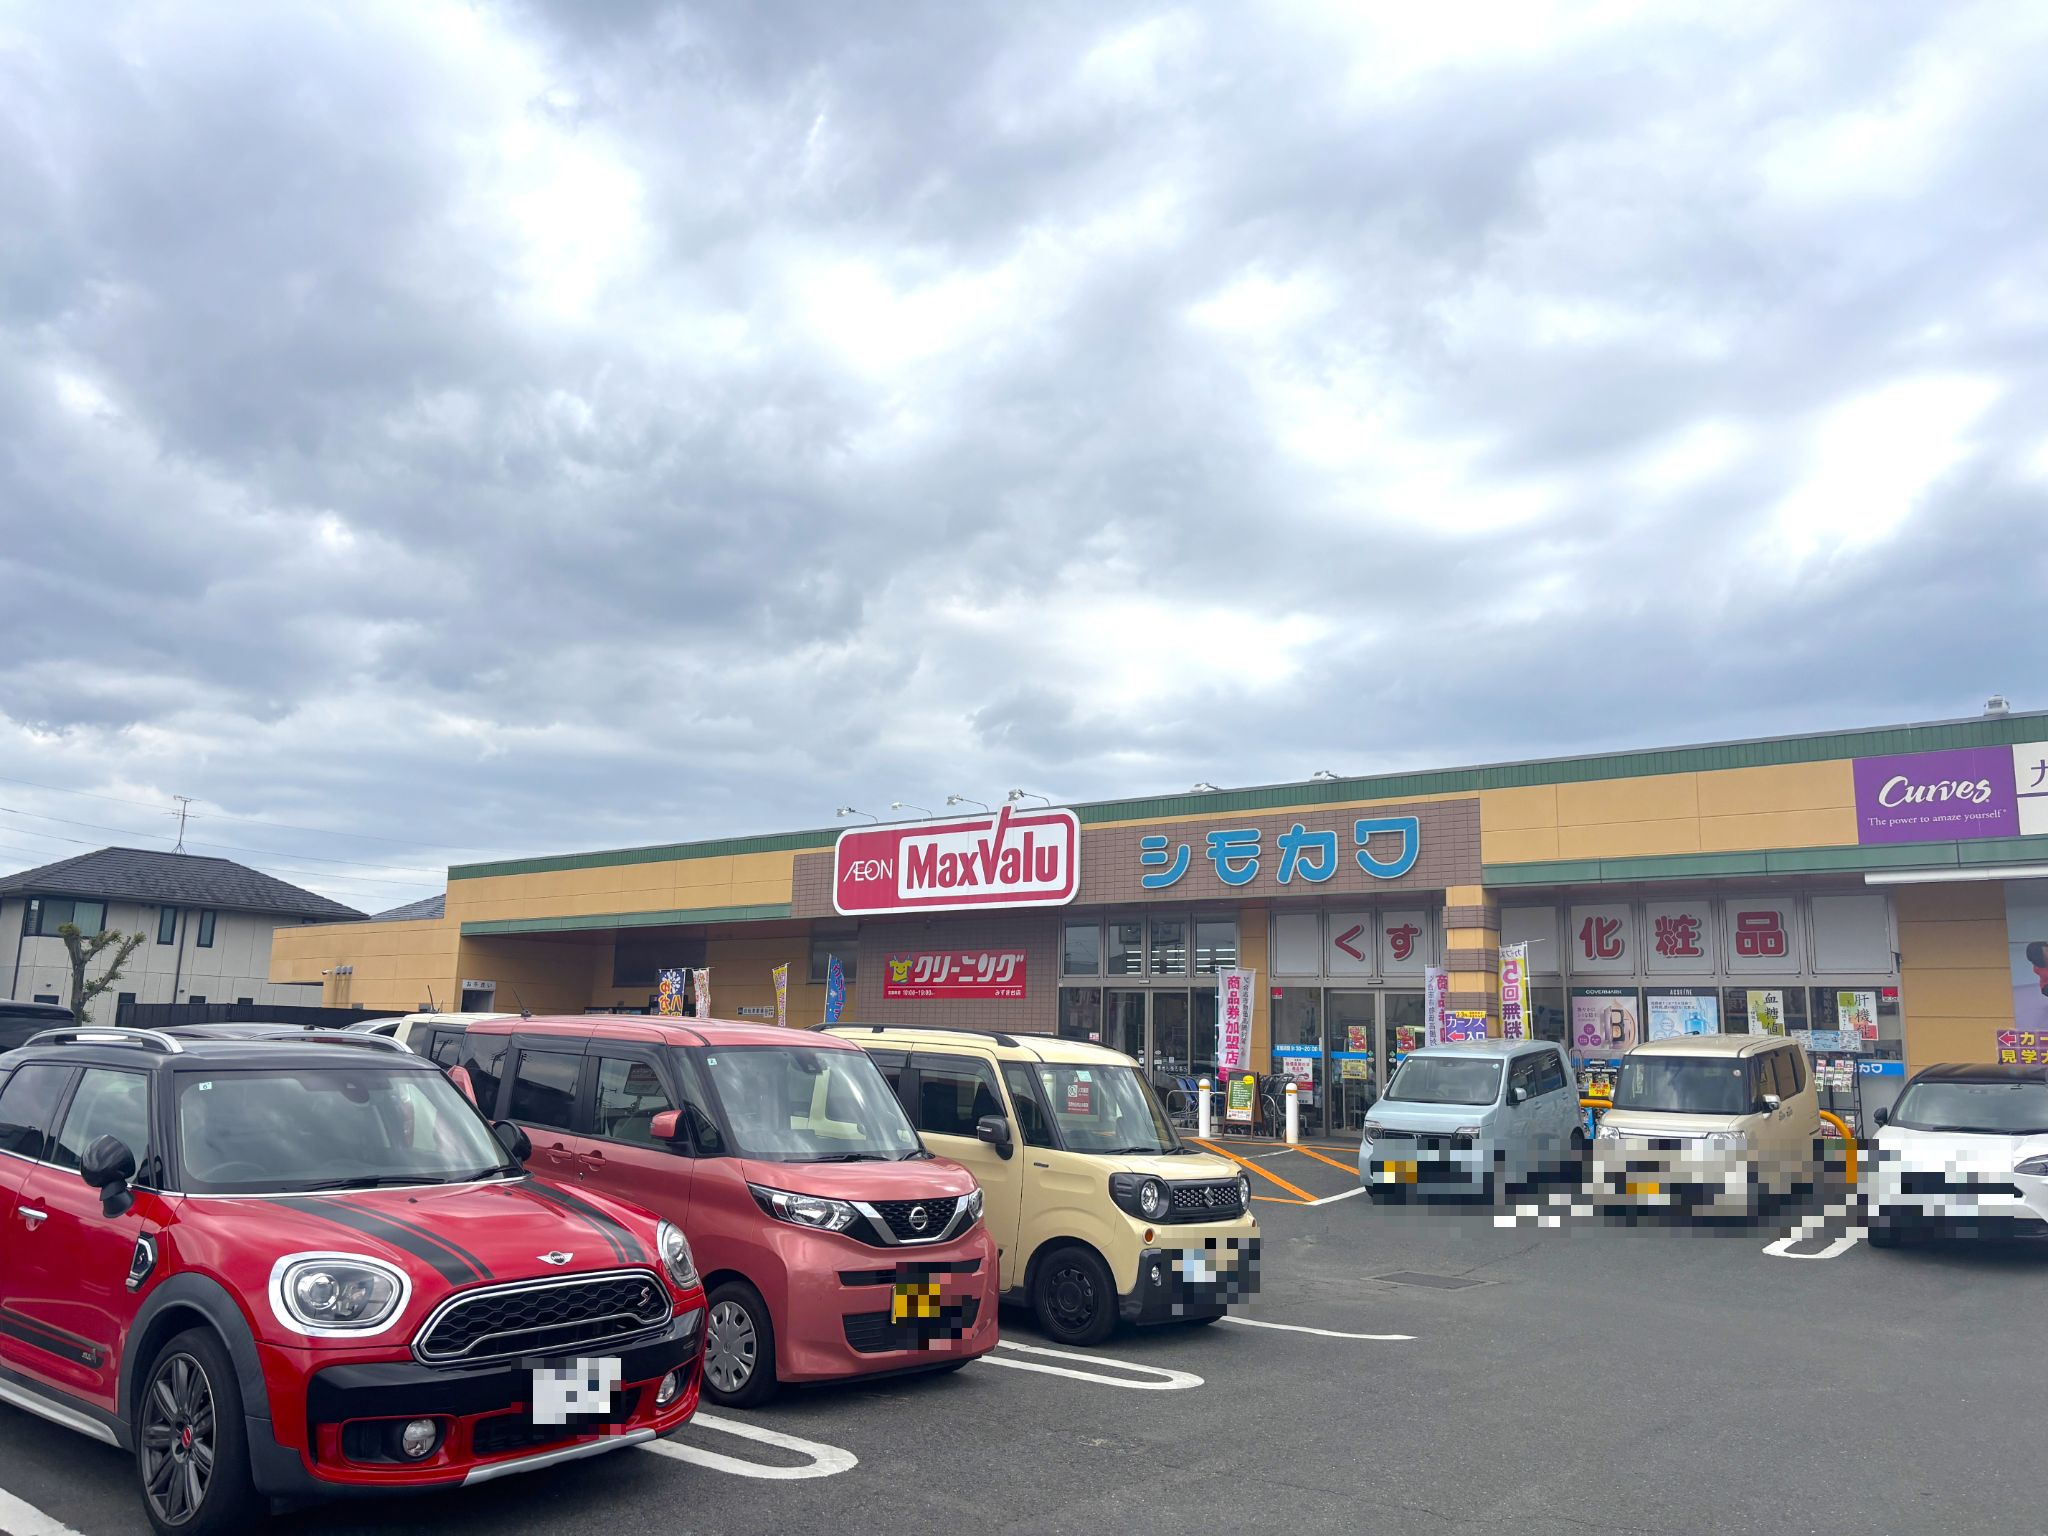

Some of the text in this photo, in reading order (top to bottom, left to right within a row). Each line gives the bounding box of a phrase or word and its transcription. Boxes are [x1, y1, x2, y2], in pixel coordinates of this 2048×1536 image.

[1878, 775, 1992, 808] Curves
[1867, 809, 2002, 828] The power to amaze yourself
[906, 806, 1059, 890] MaxValu
[1140, 815, 1420, 889] シモカワ
[1578, 910, 1788, 960] 化粧品
[914, 953, 1025, 983] クリーニング
[1225, 975, 1240, 1065] 商品券加盟店
[1466, 1031, 1485, 1041] 入口
[1763, 992, 1779, 1036] 血糖値
[1854, 994, 1873, 1039] 肝機能
